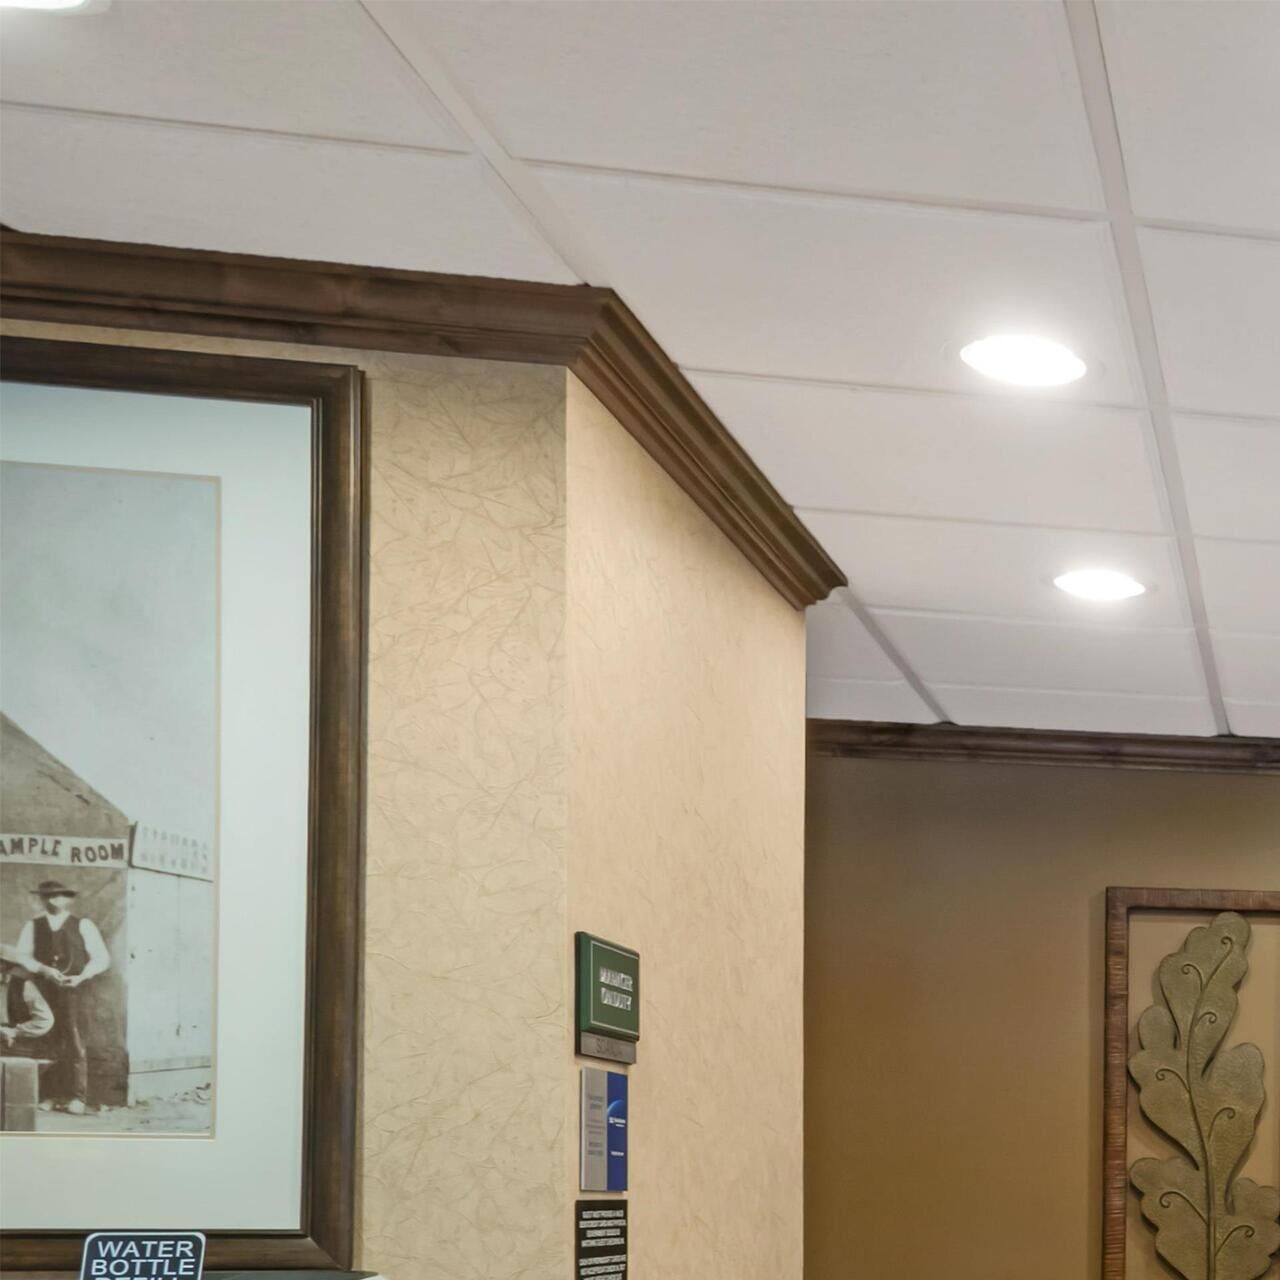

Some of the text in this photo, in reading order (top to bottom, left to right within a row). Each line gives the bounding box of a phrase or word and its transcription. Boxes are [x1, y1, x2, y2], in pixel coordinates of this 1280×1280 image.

[71, 843, 125, 863] ROOM
[97, 1240, 195, 1258] WATER
[91, 1258, 196, 1276] BOTTLE
